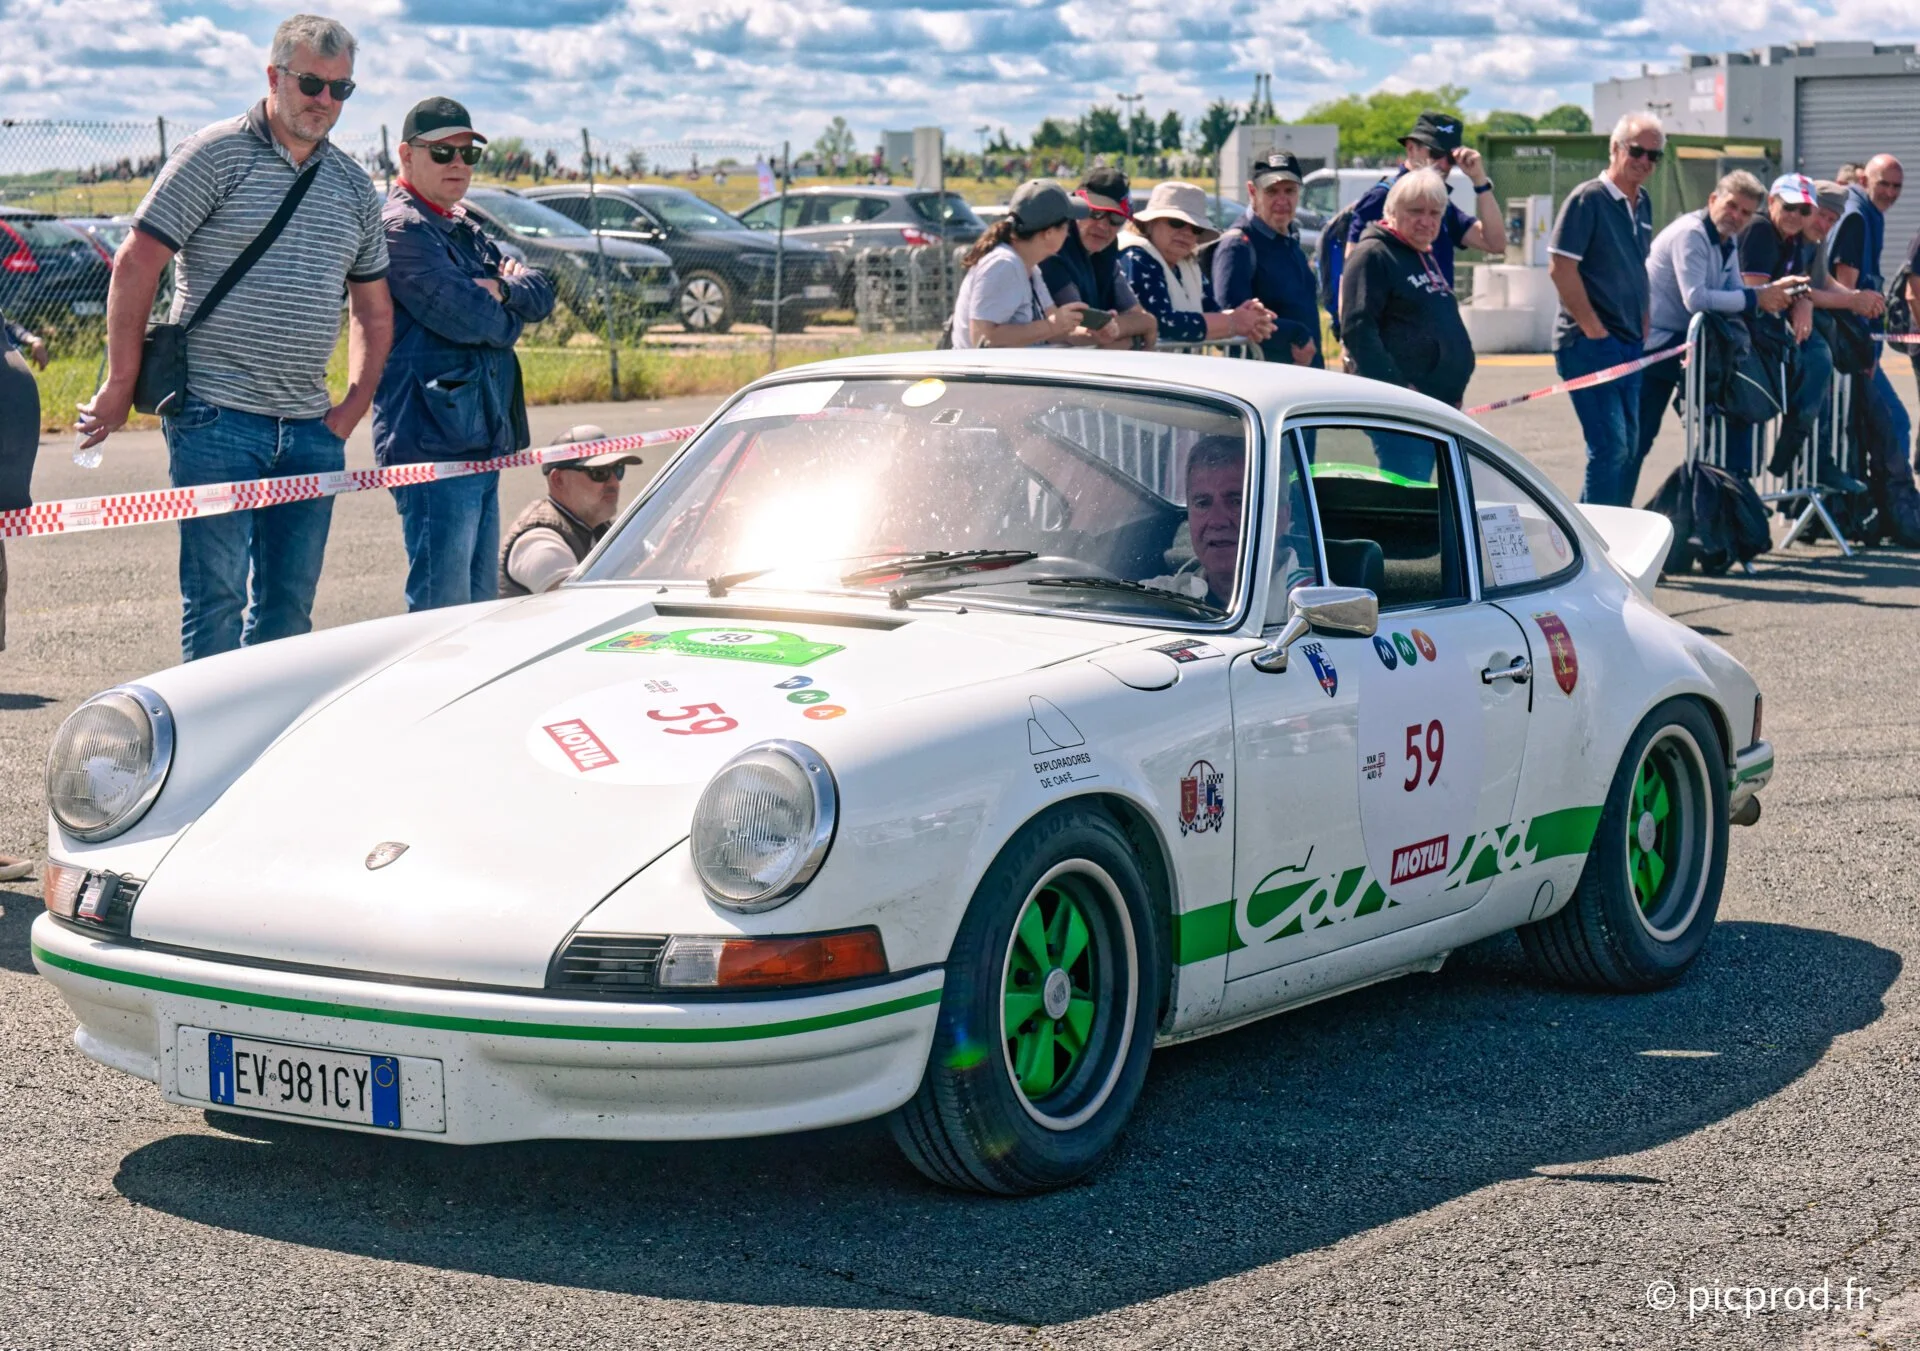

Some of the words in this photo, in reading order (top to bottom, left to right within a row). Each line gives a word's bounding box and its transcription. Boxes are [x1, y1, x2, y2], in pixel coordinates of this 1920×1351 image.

[711, 632, 753, 643] 59
[646, 702, 739, 736] 59
[550, 722, 611, 769] MOTUL
[1404, 719, 1445, 792] 59
[1033, 752, 1092, 774] EXPLORADORES
[1040, 777, 1054, 789] DE
[1393, 840, 1446, 880] MOTUL
